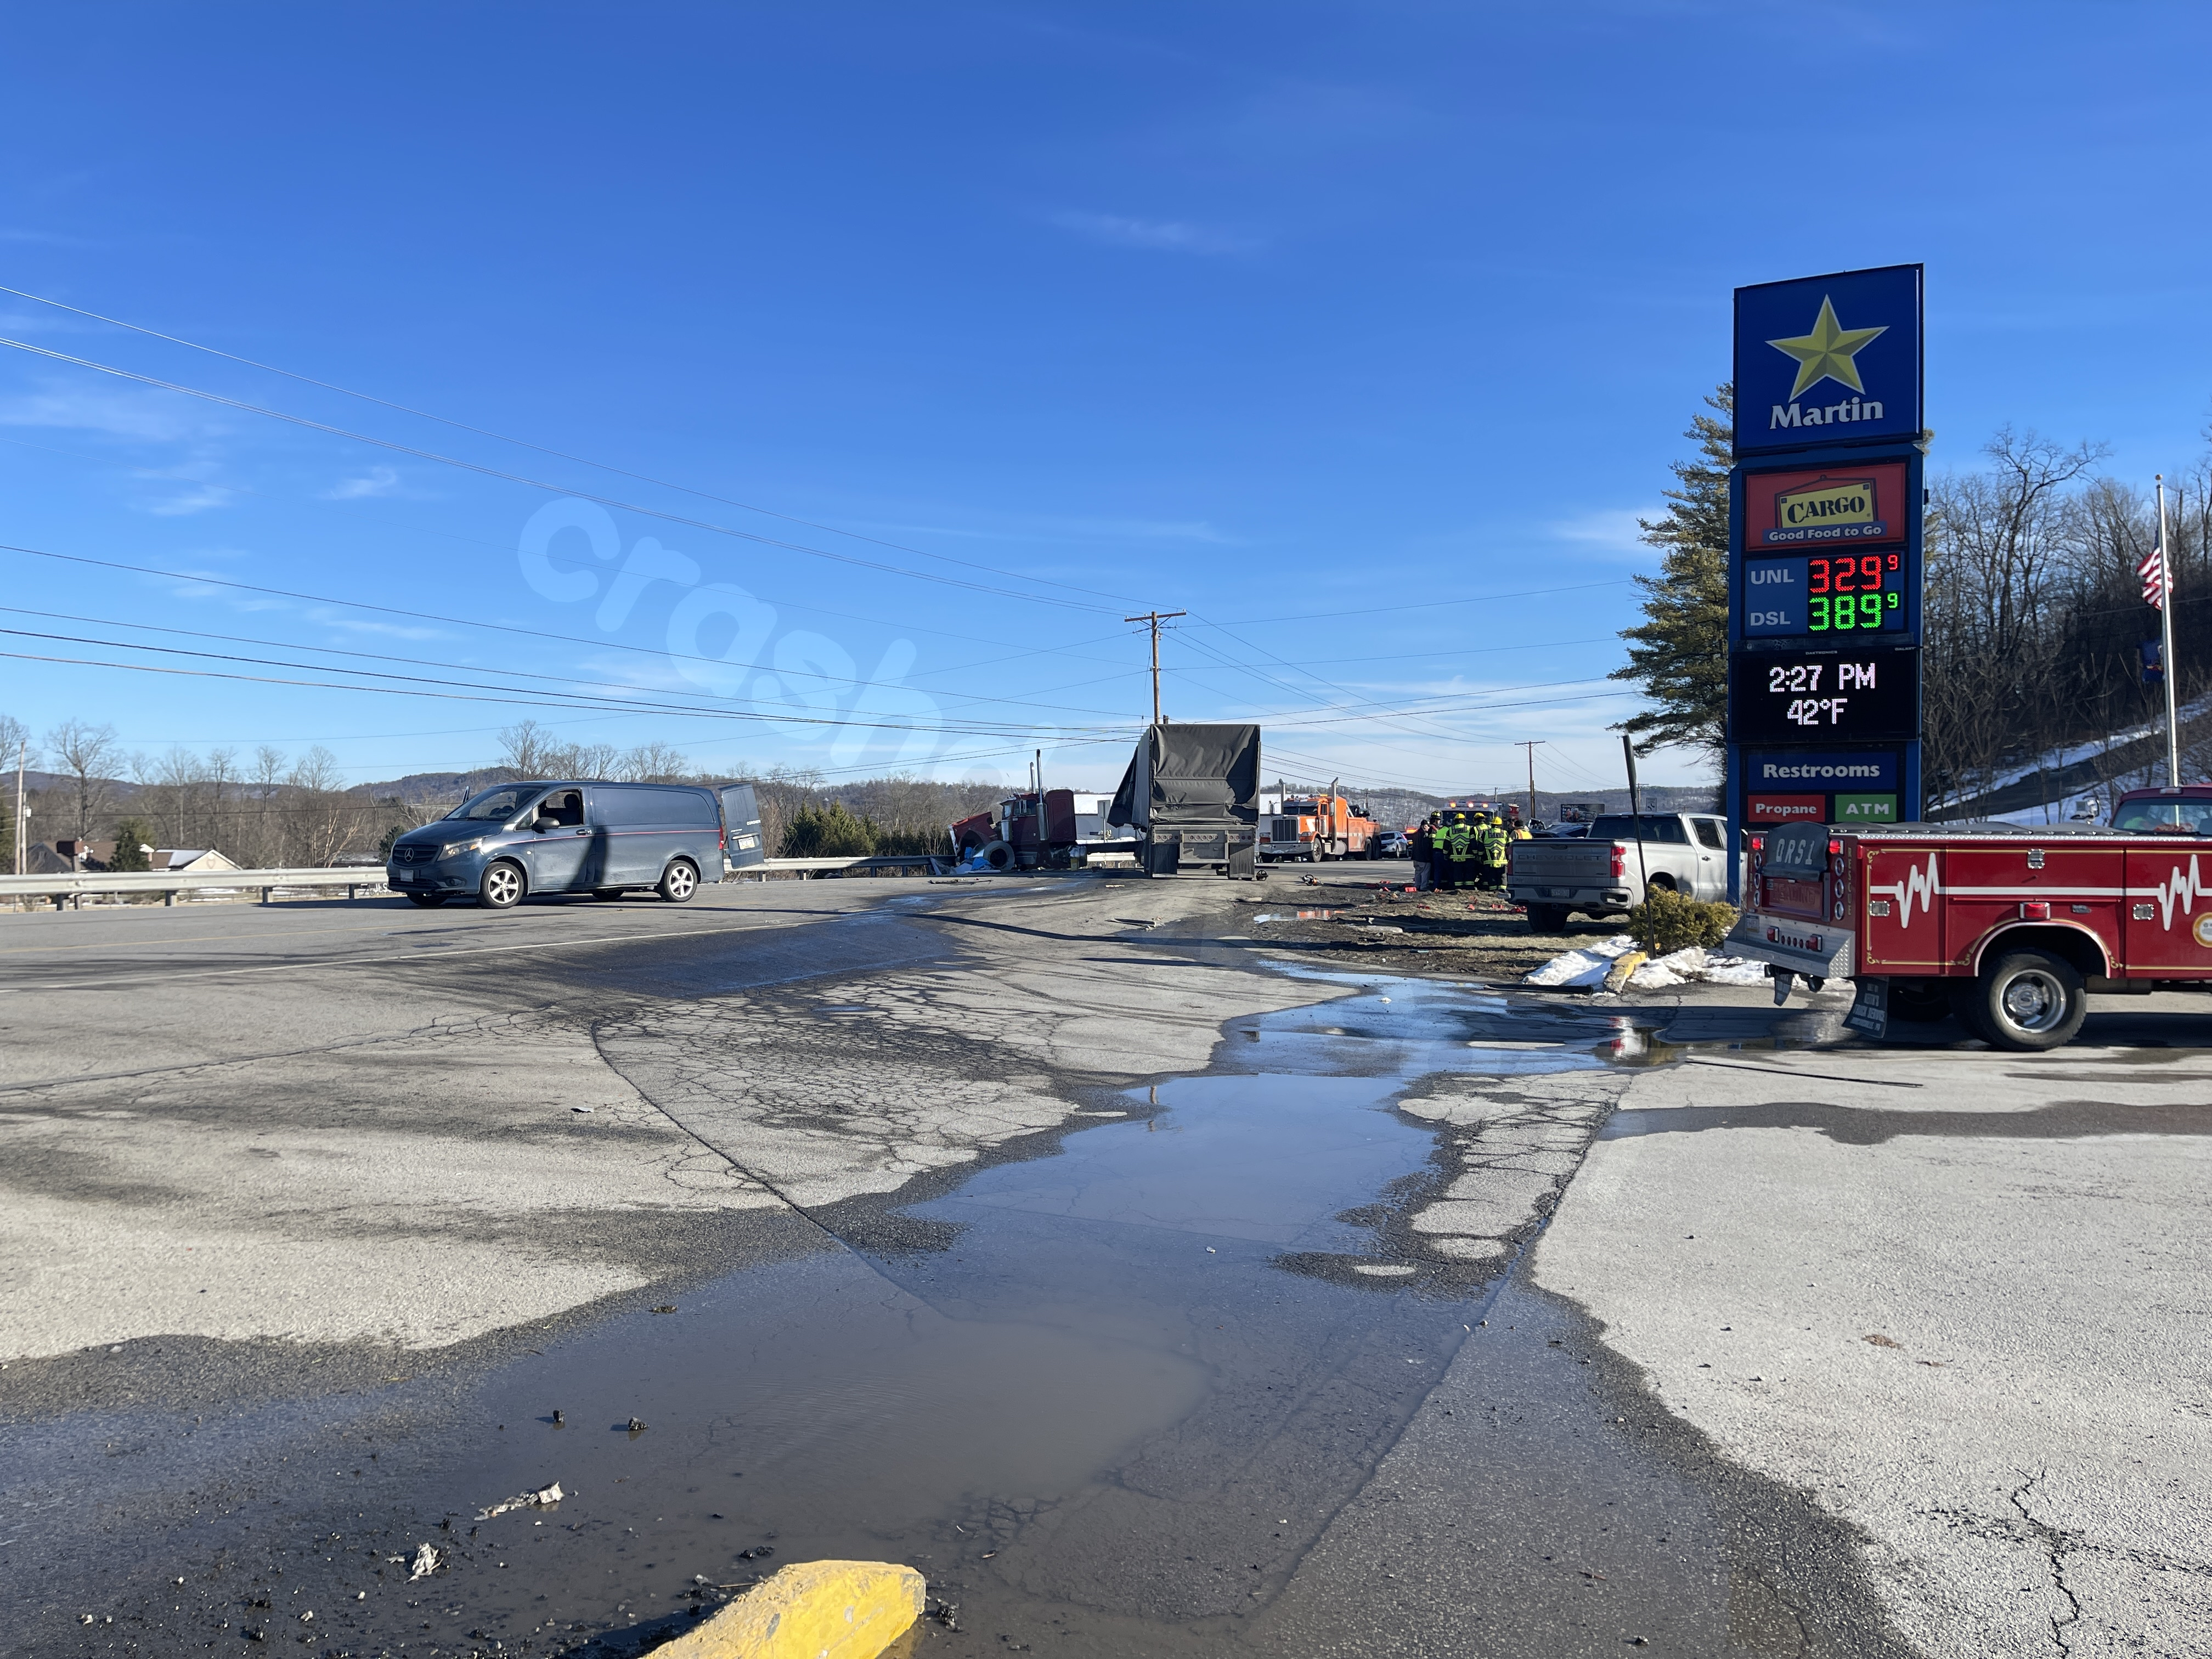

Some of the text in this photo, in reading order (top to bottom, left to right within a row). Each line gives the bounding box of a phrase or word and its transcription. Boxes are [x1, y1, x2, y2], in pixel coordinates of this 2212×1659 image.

[1769, 396, 1884, 430] Martin
[1787, 495, 1865, 523] CARGO
[1769, 525, 1882, 541] Good Food to Go
[1750, 568, 1795, 585] UNL
[1750, 611, 1791, 627] DSL
[1769, 662, 1876, 692] 2:27 PM
[1786, 698, 1848, 725] 42°F
[1763, 763, 1881, 778] Restrooms
[1756, 803, 1817, 817] Propane
[1845, 803, 1889, 815] ATM
